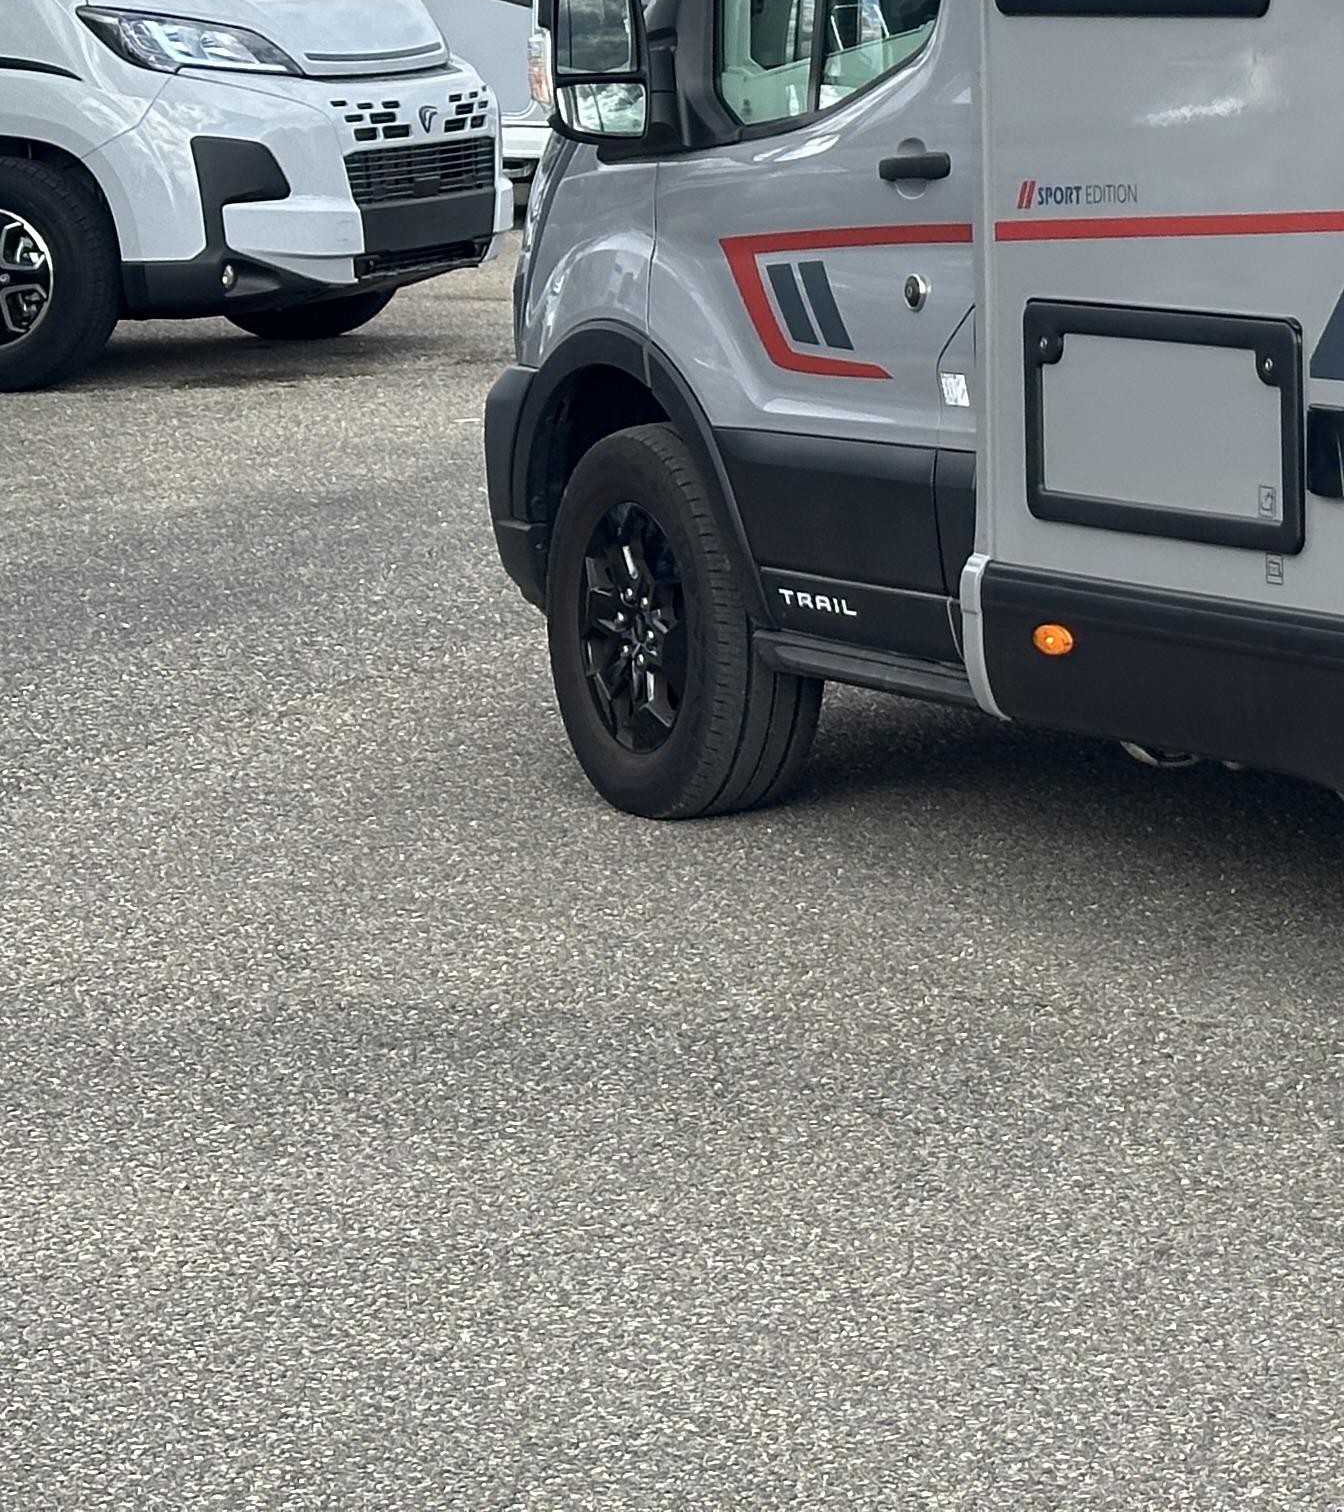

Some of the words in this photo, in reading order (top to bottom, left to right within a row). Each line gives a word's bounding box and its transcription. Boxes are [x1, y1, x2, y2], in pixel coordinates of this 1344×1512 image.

[1037, 186, 1082, 206] SPORT
[1085, 184, 1138, 204] EDITION
[778, 588, 857, 617] TRAIL
